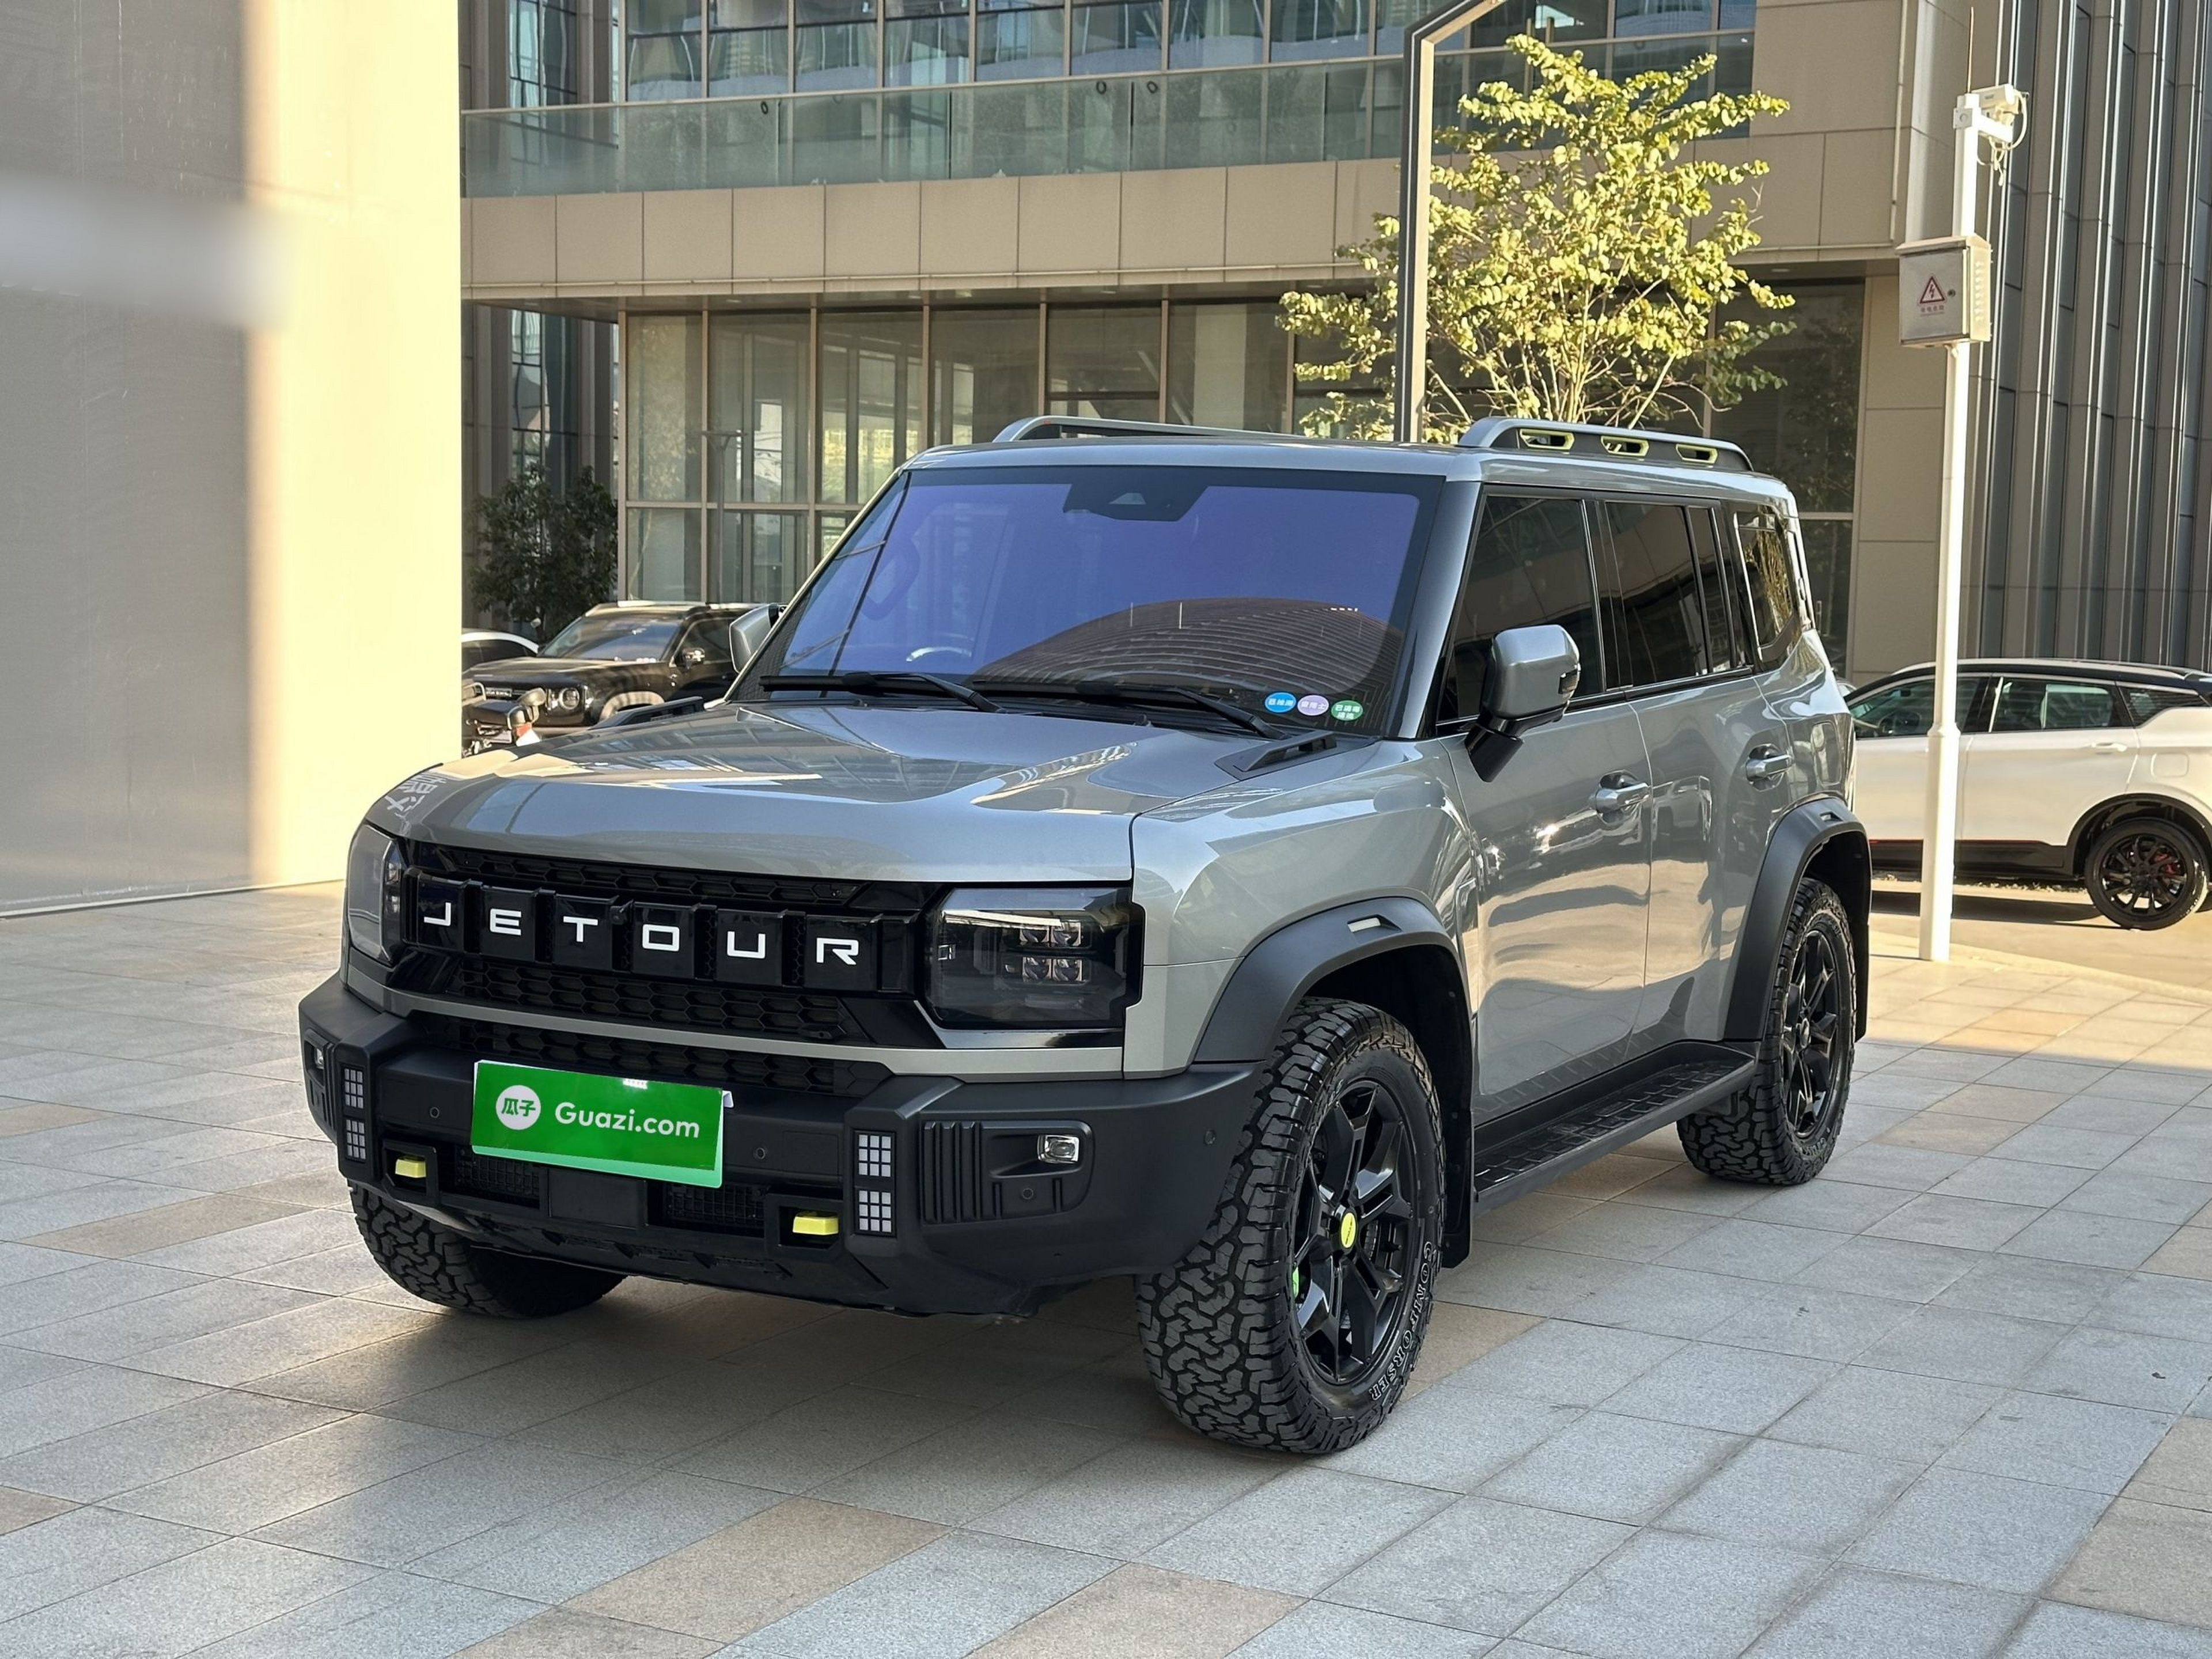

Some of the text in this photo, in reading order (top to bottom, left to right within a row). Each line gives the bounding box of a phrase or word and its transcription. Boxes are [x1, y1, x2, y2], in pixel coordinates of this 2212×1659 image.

[423, 902, 859, 965] JETOUR
[501, 1097, 536, 1116] 瓜子
[555, 1101, 700, 1138] Guazi.com
[1369, 1241, 1437, 1400] COMFORSER
